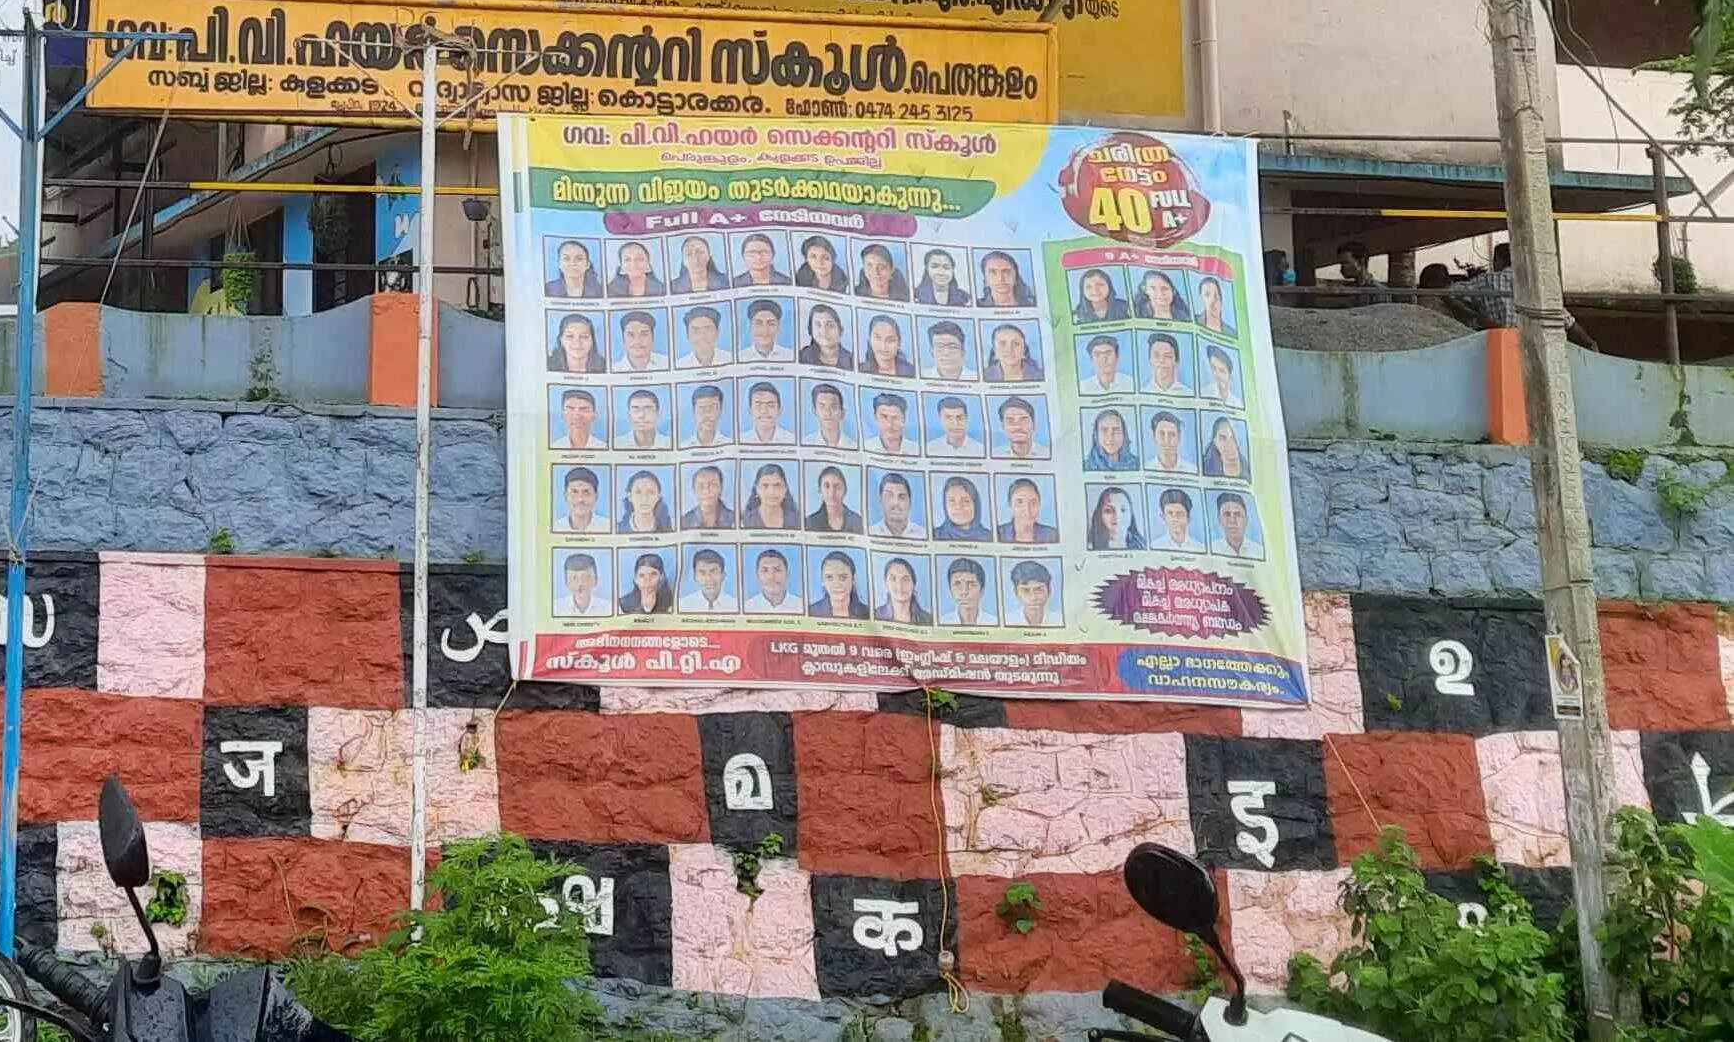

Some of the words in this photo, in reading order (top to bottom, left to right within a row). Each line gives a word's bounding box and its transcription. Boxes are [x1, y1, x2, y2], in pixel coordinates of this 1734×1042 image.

[855, 102, 895, 118] 0474
[898, 103, 931, 119] 245
[933, 104, 974, 121] 3125
[563, 125, 611, 146] ഗവ:
[905, 126, 998, 158] സ്കൂൾ
[552, 174, 630, 208] മിന്നുന്ന
[638, 175, 722, 204] വിജയം
[1149, 189, 1192, 208] FULL
[645, 211, 699, 229] Full
[709, 212, 748, 226] A+
[1089, 187, 1154, 235] 40
[1161, 210, 1189, 229] A+
[545, 651, 637, 674] സ്കൂൾ
[1429, 639, 1476, 697] ഉ
[220, 740, 284, 798] ज
[722, 752, 774, 810] മ
[852, 897, 924, 957] क
